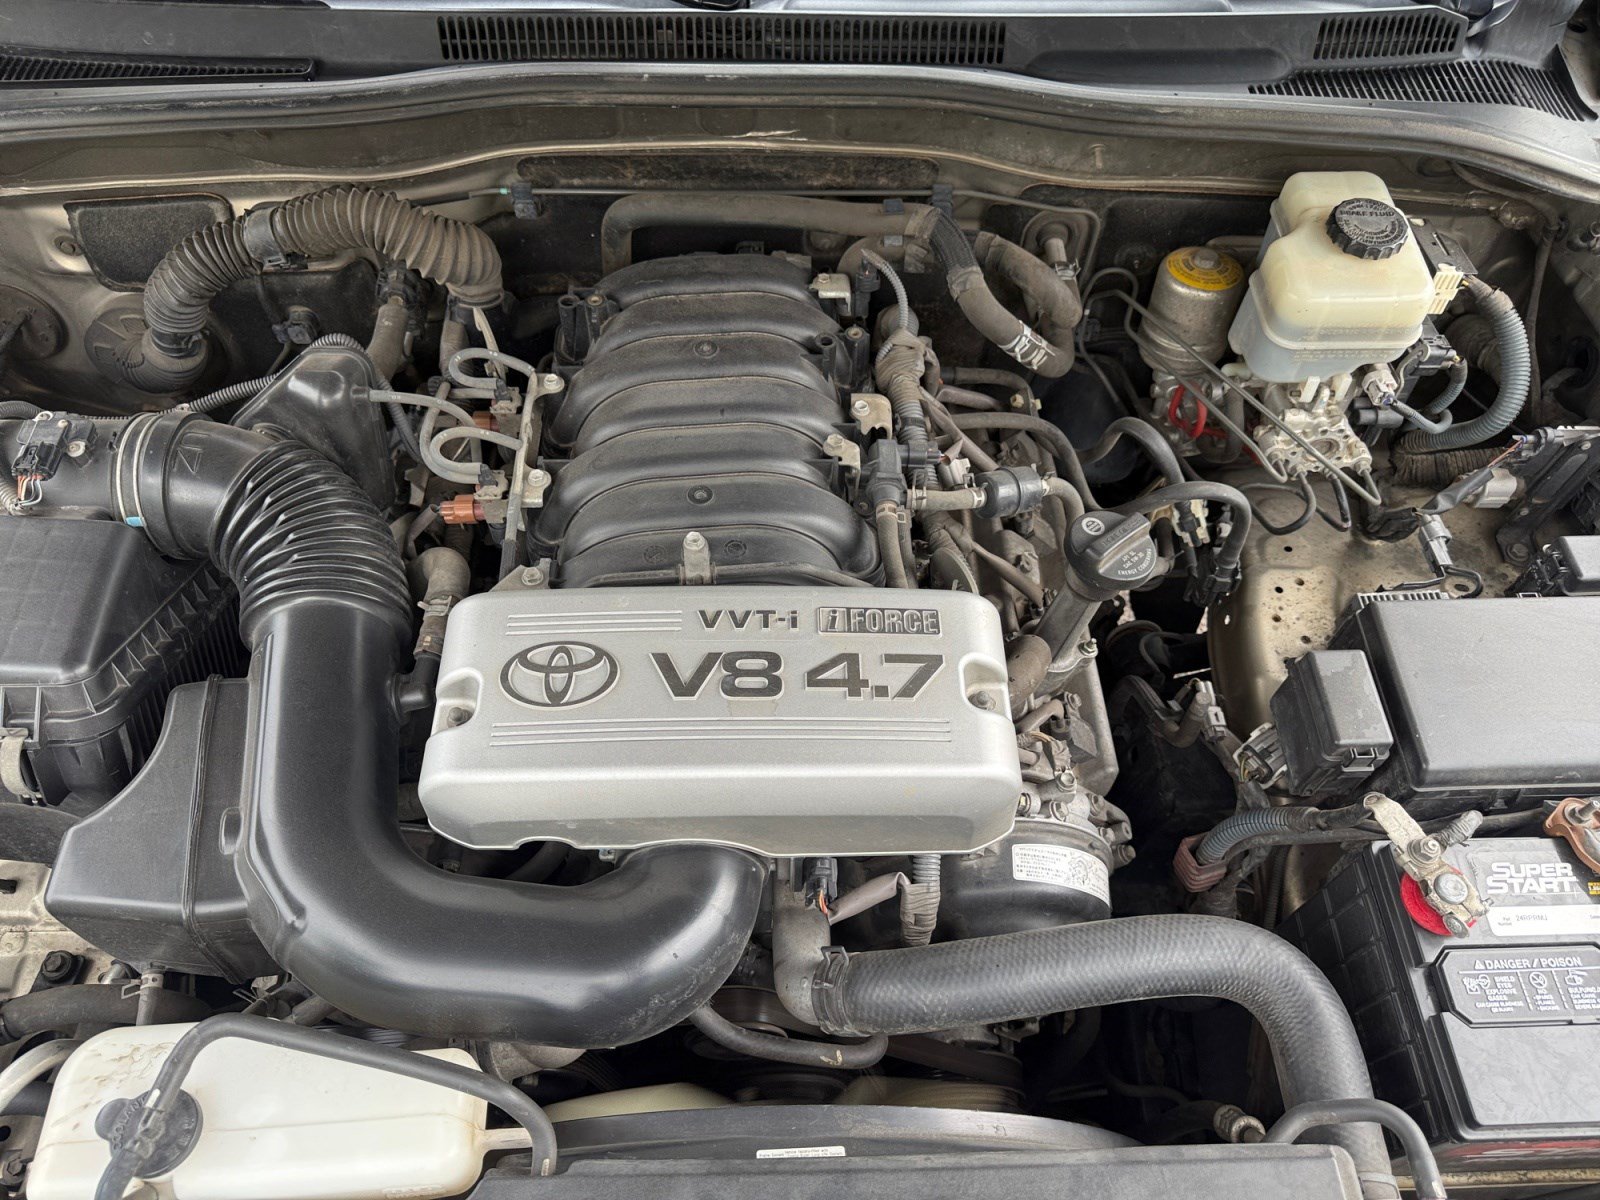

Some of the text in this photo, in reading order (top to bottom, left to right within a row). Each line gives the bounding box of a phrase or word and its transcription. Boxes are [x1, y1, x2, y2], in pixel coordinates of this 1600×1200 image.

[698, 609, 799, 631] VVT-i
[649, 650, 945, 701] V8 4.7
[1491, 862, 1573, 878] SUPER
[1486, 875, 1579, 895] START
[1484, 958, 1531, 970] DANGER
[1540, 956, 1583, 968] POISON
